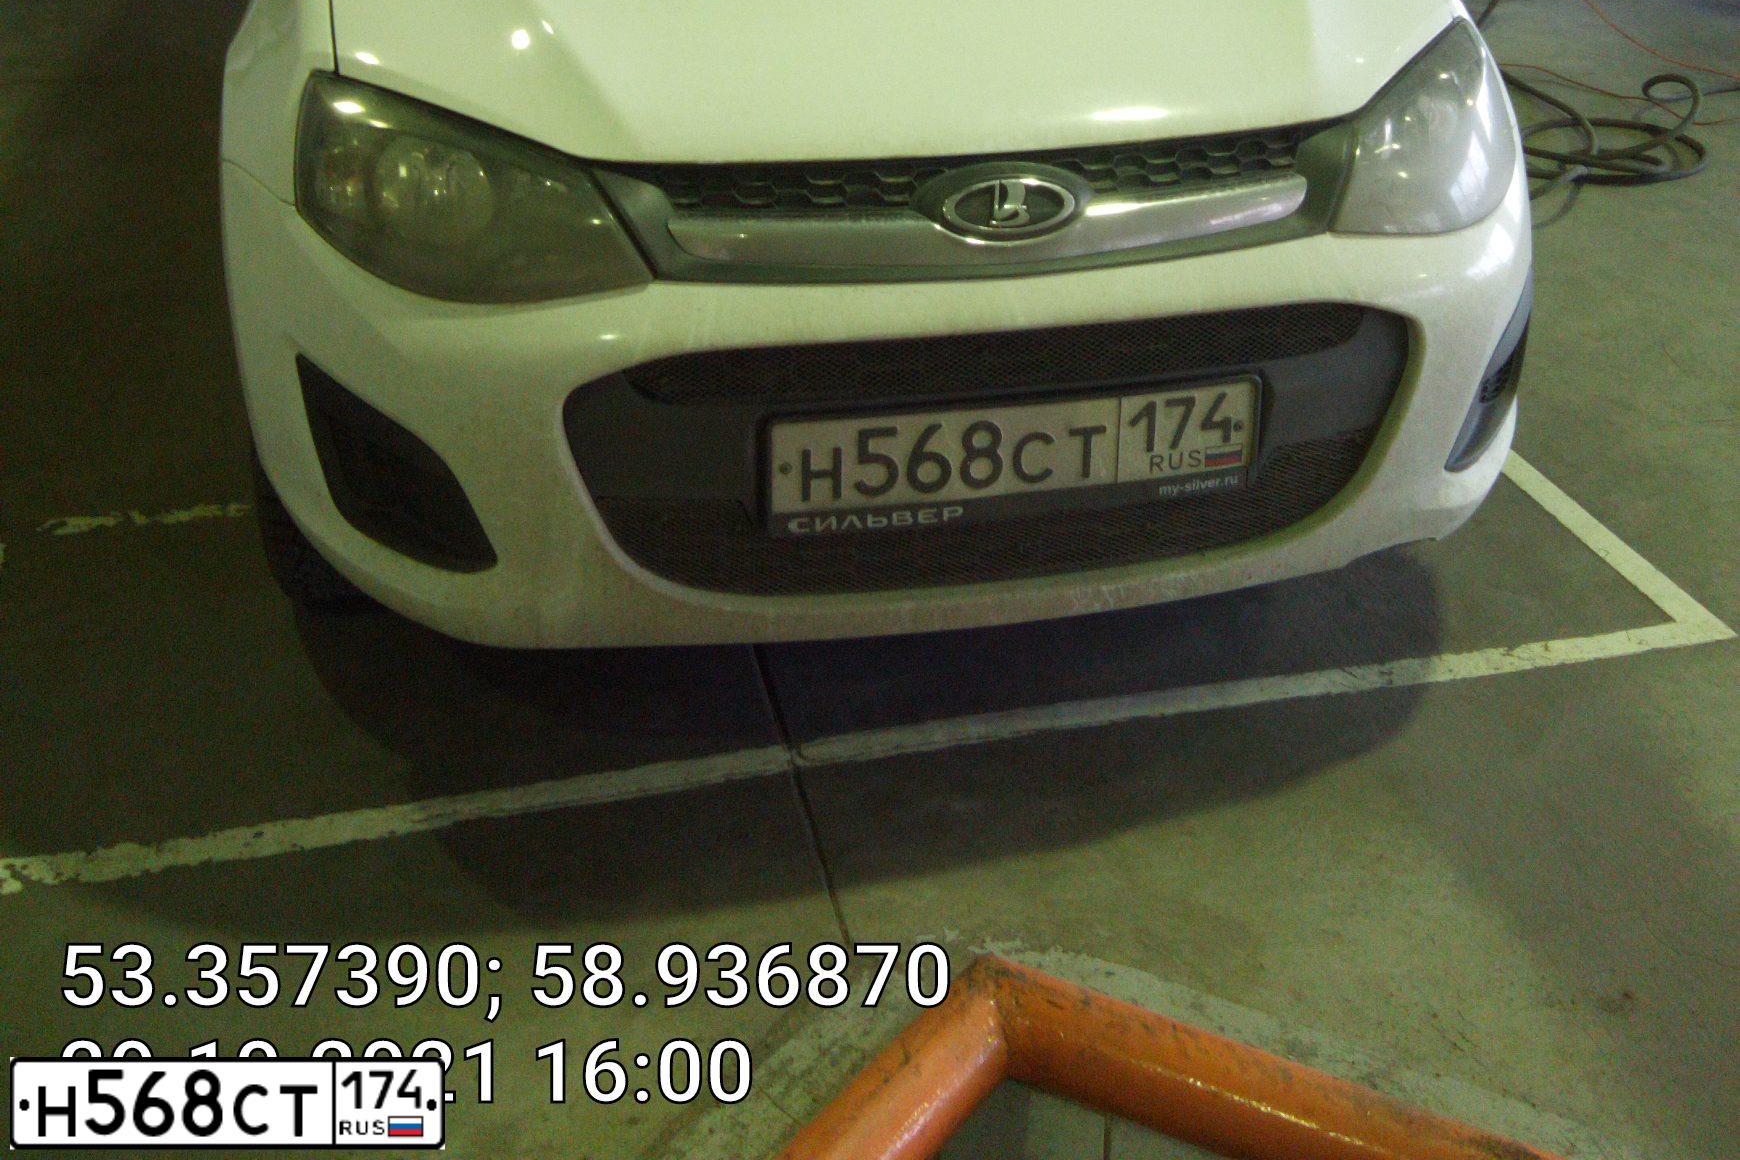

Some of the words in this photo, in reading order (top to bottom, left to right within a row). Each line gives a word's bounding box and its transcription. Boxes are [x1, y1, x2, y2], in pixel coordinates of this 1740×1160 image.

[1128, 391, 1233, 454] 174
[1149, 450, 1202, 474] RUS
[1158, 474, 1239, 497] my-silver.ru
[787, 505, 964, 533] СИЛЬВЕР
